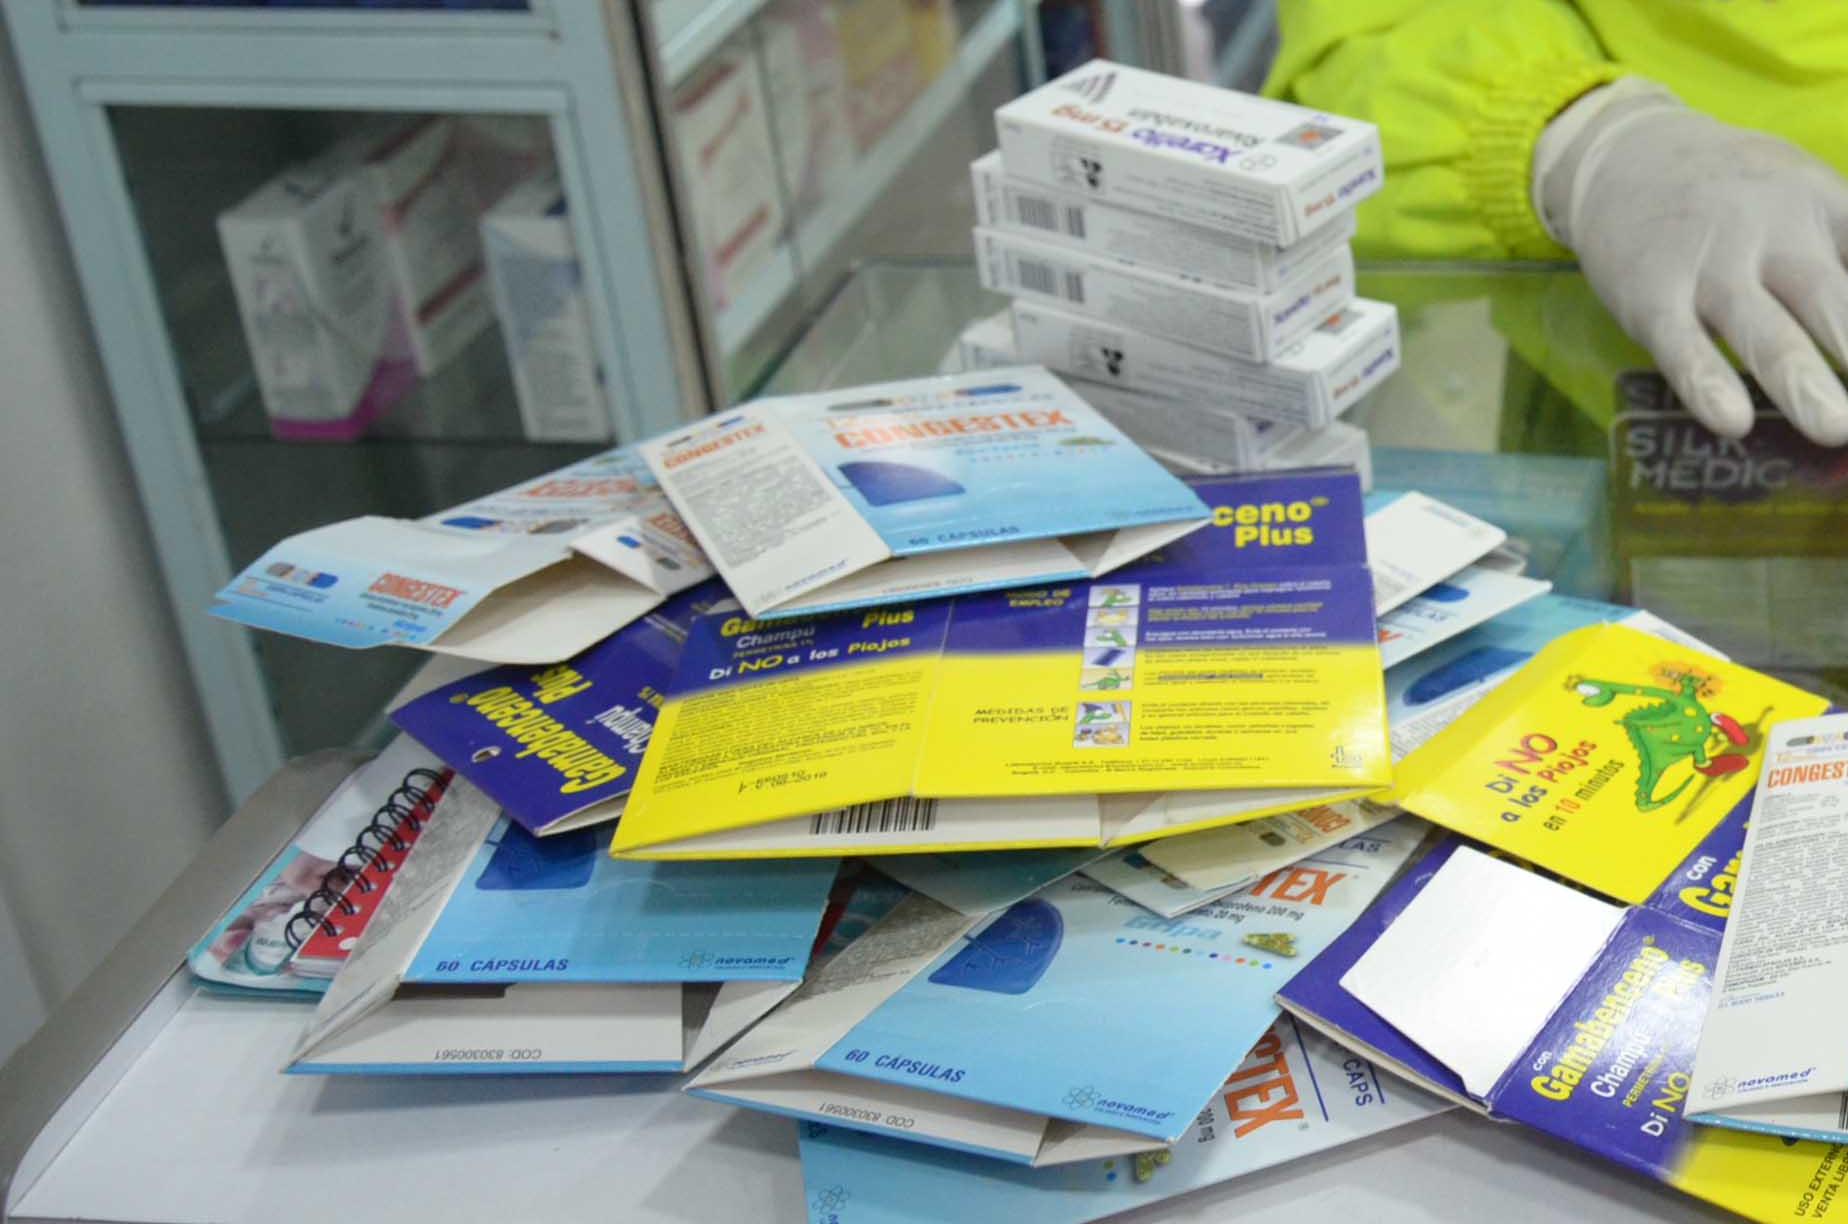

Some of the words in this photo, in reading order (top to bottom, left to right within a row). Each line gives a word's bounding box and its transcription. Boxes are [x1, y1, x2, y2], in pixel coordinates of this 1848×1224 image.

[834, 408, 1073, 449] CONGESTEX
[1630, 458, 1791, 490] MEDIC
[1234, 525, 1315, 549] Plus
[861, 610, 915, 629] Plus
[737, 655, 784, 674] NO
[786, 655, 801, 665] a
[808, 648, 840, 661] los
[847, 636, 912, 655] Piojos
[474, 686, 627, 794] Gamabenceno
[1494, 733, 1559, 775] NO
[1536, 740, 1598, 785] Piojos
[1485, 773, 1520, 794] Di
[1575, 759, 1626, 801] minutos
[1507, 784, 1549, 809] los
[1555, 797, 1582, 815] 10
[1500, 810, 1522, 823] a
[1543, 815, 1568, 832] en
[1686, 854, 1718, 881] con
[434, 959, 461, 973] 60
[1530, 946, 1670, 1102] Gamabenceno
[433, 1048, 505, 1062] 830300561
[845, 1047, 871, 1065] 60
[1532, 1050, 1552, 1071] con
[1343, 1057, 1374, 1107] CAPS
[1651, 1070, 1691, 1112] NO
[1736, 1068, 1813, 1089] novamed
[1096, 1098, 1171, 1121] novamed
[1641, 1112, 1669, 1138] Di
[1794, 1191, 1816, 1218] USO
[1811, 1183, 1838, 1219] VENTA
